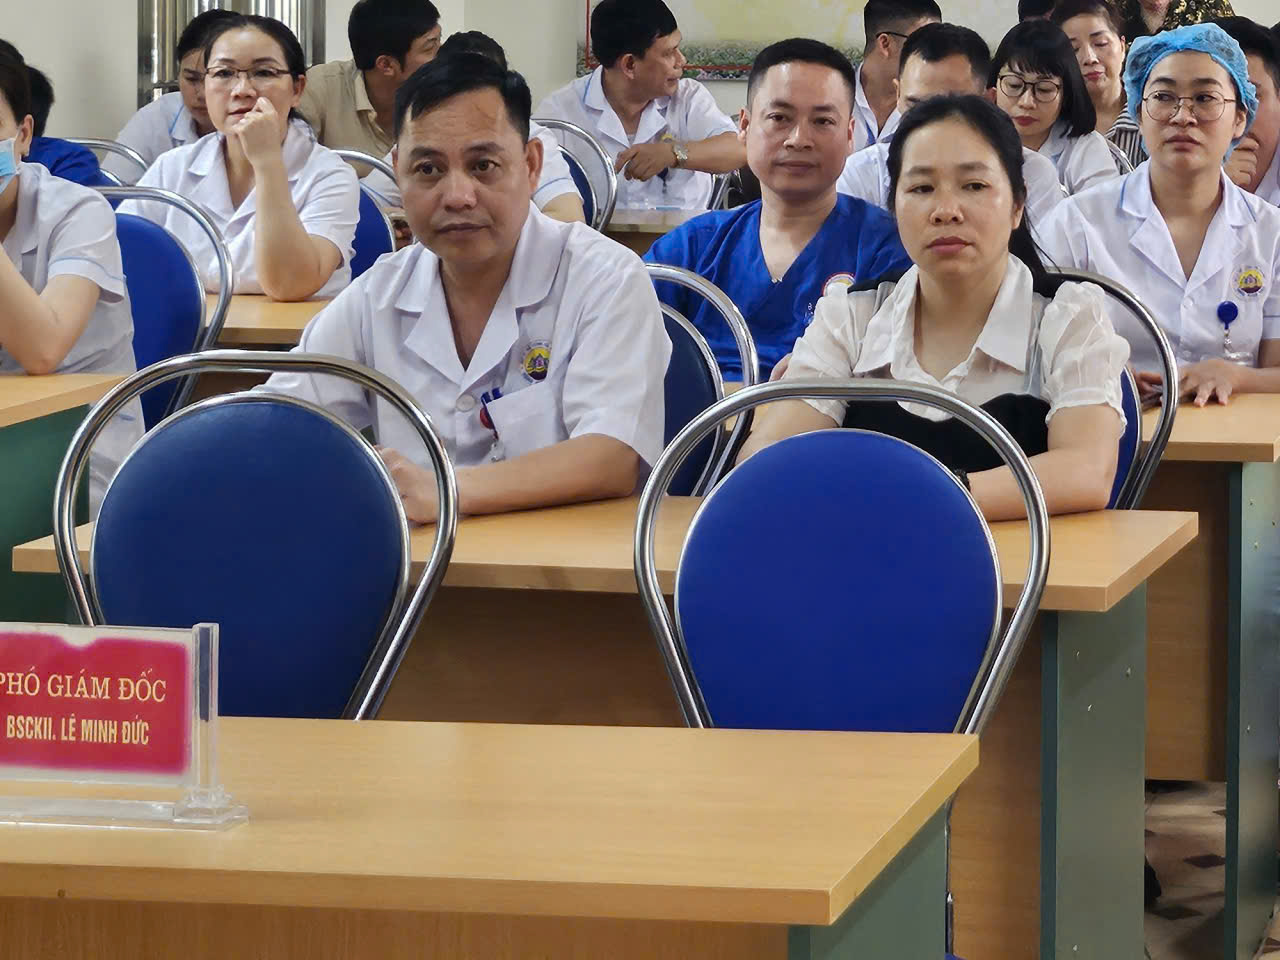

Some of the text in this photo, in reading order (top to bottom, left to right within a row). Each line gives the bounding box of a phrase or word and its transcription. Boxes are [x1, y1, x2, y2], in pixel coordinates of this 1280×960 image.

[47, 668, 111, 699] GIÁM
[117, 668, 167, 702] ĐỐC
[6, 713, 150, 745] BSCKII. LÊ MINH ĐỨC
